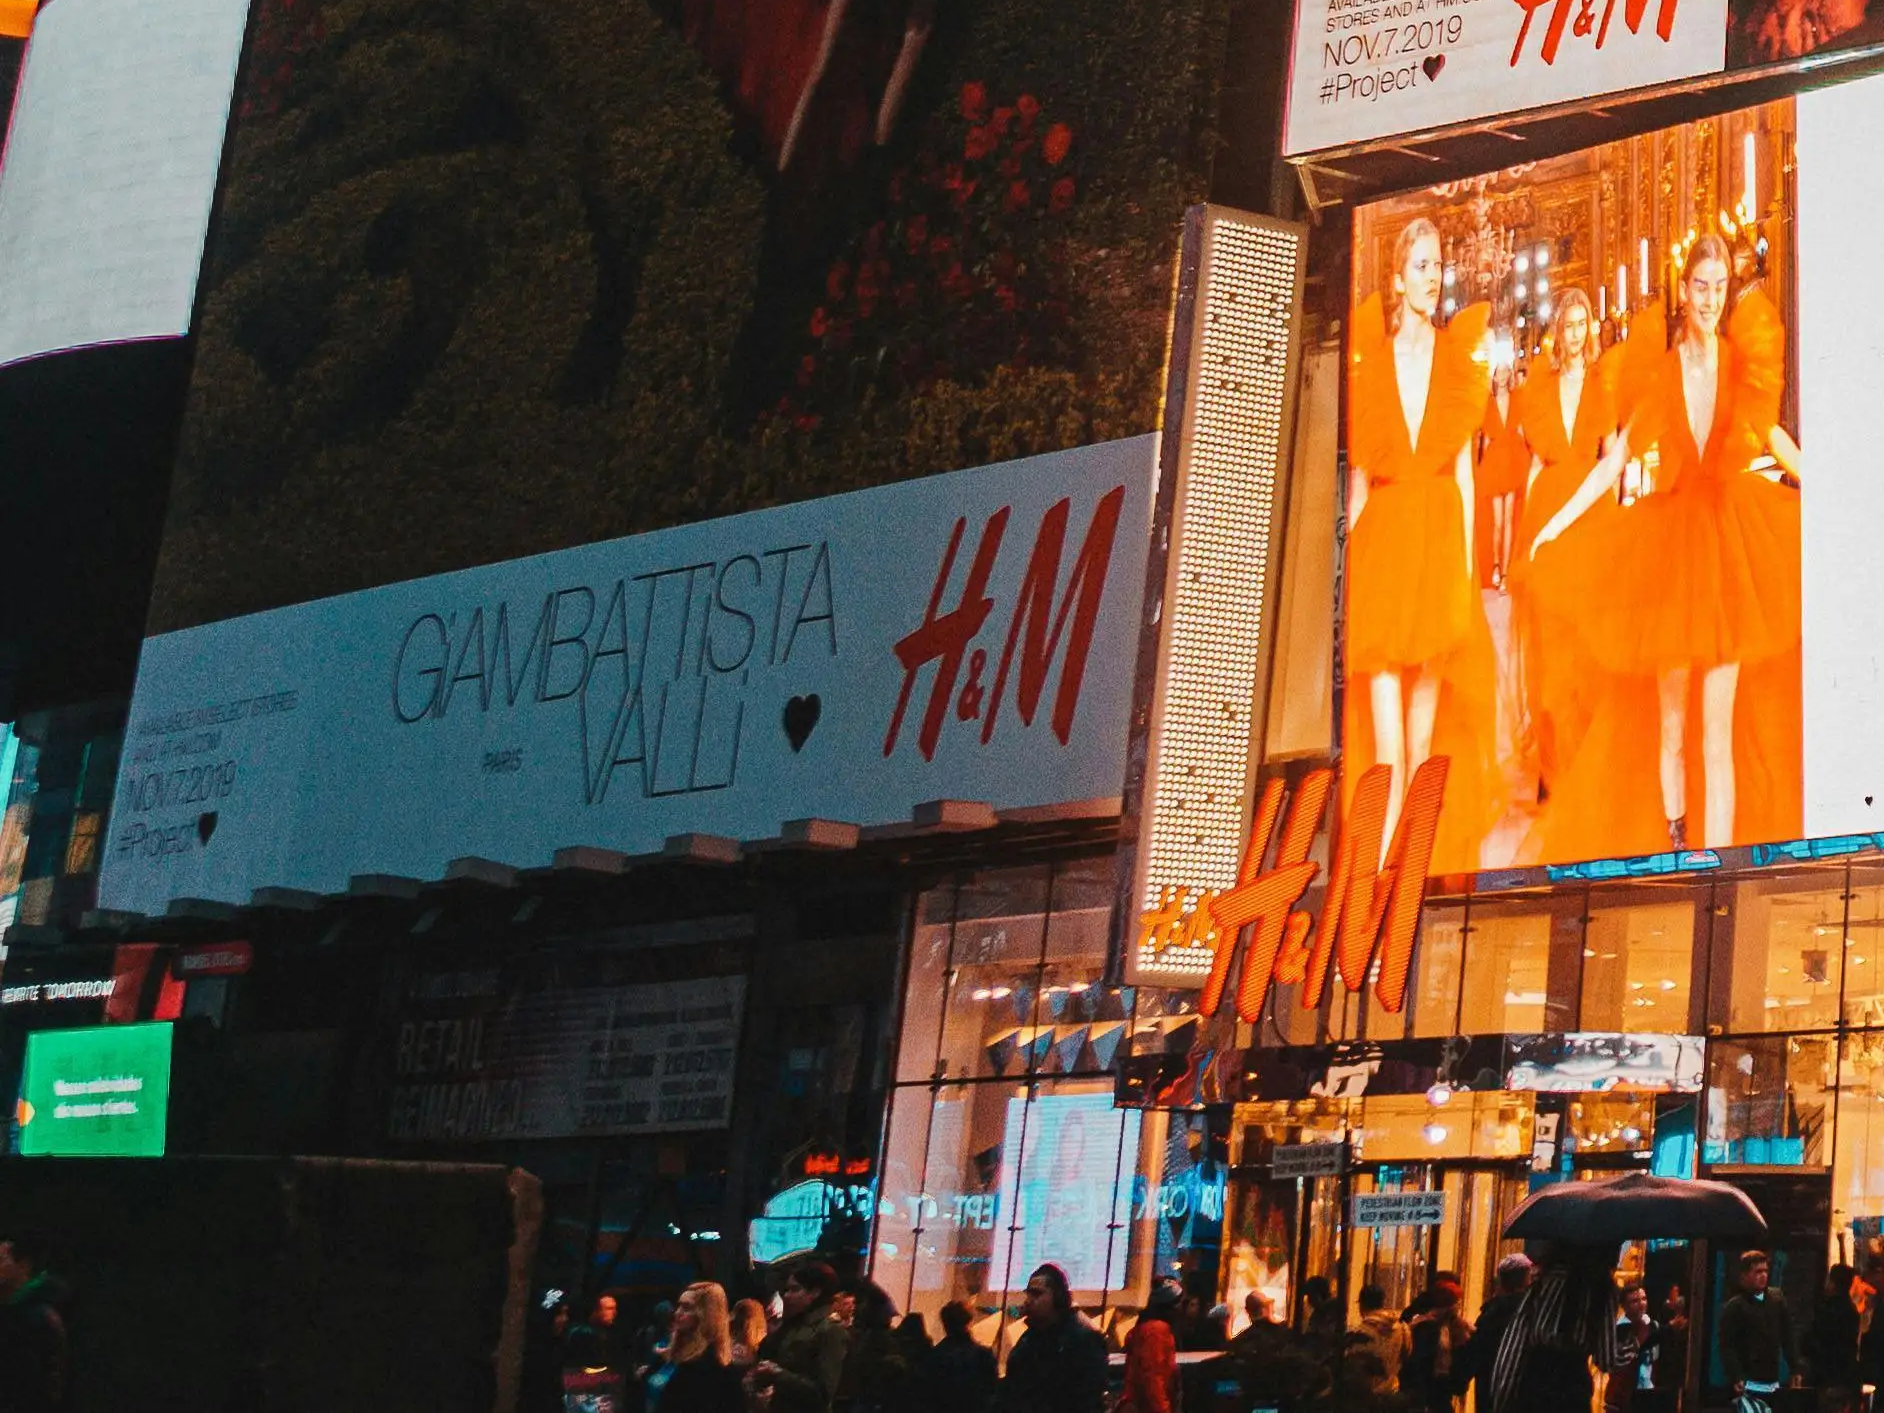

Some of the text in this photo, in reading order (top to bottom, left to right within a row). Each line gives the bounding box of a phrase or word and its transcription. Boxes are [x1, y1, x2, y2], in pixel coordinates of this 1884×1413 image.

[1323, 14, 1464, 68] NOV.7.2019
[1326, 10, 1380, 33] STORES
[1384, 2, 1413, 21] AND
[1319, 60, 1418, 105] #Project
[883, 484, 1127, 763] H&M
[1200, 754, 1451, 1024] H&M
[397, 1017, 485, 1073] RETAIL
